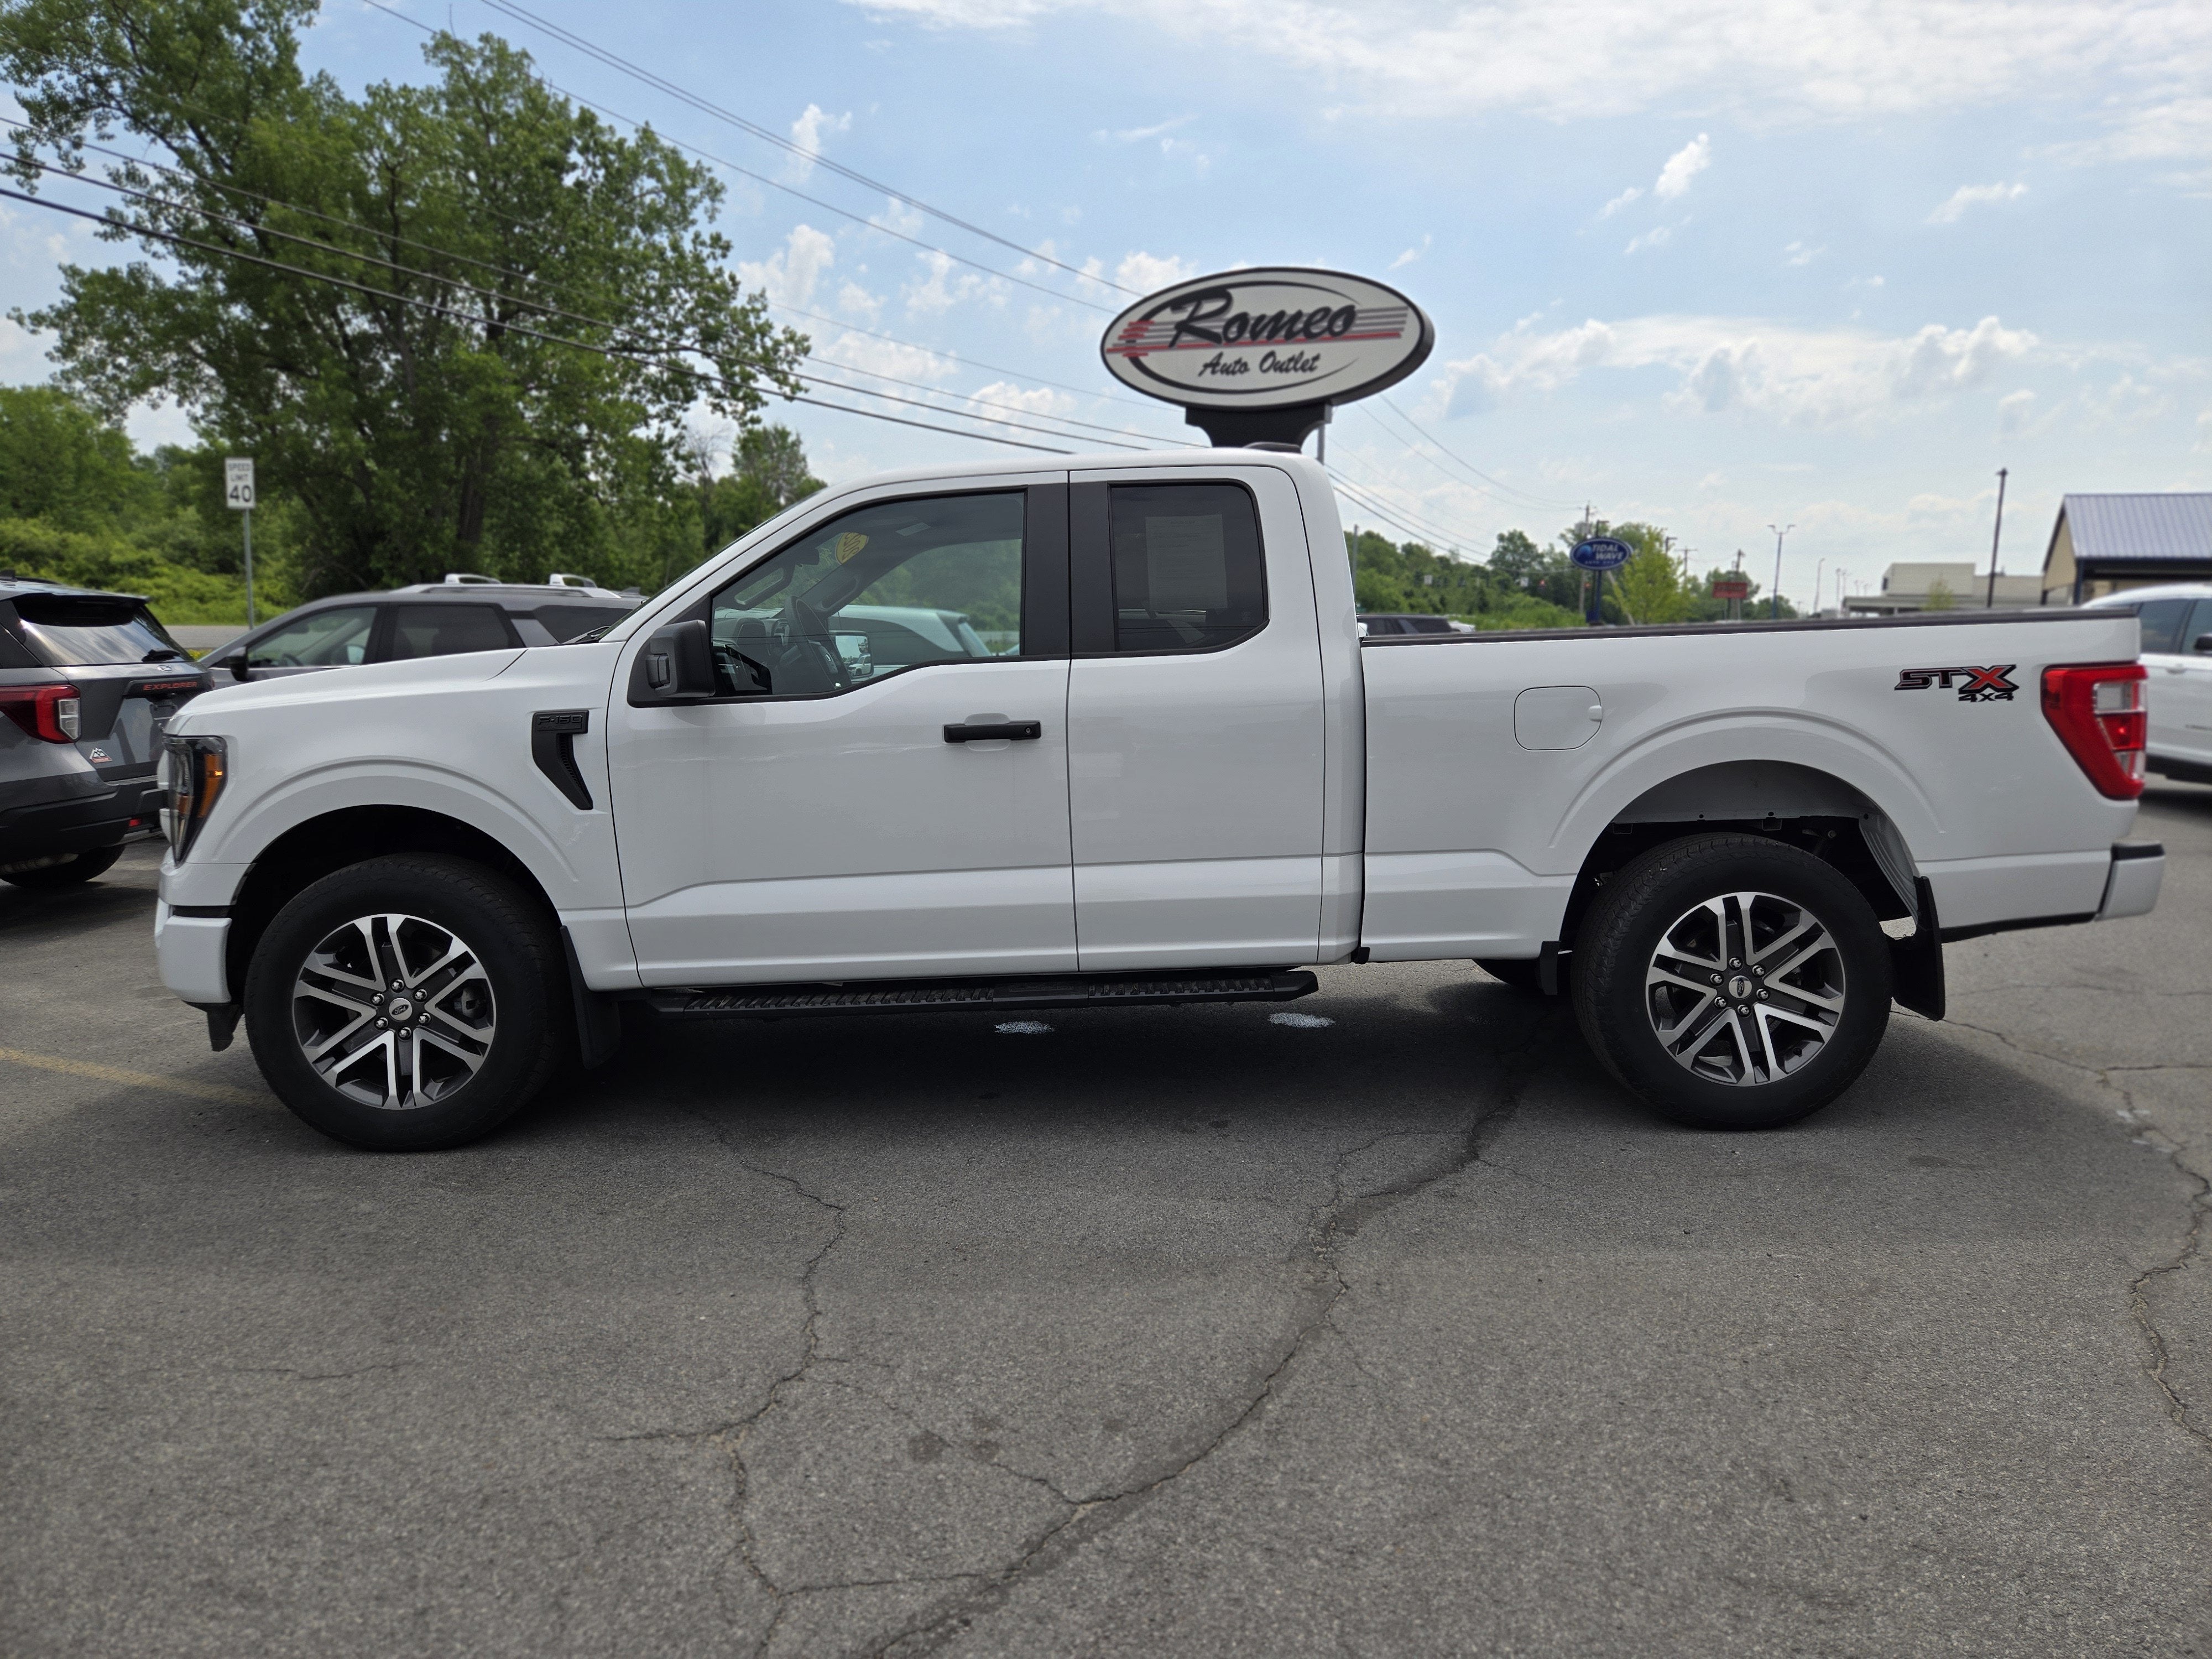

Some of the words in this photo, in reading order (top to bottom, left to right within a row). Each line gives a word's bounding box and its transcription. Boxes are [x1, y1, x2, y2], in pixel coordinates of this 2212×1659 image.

[1168, 288, 1357, 348] Romeo
[1198, 352, 1250, 376] Auto
[1259, 351, 1321, 373] Outlet
[229, 485, 252, 502] 40
[1593, 544, 1619, 552] TIDAL
[143, 681, 197, 691] EXPLORER
[1895, 664, 2020, 695] STX
[538, 714, 583, 725] F-150
